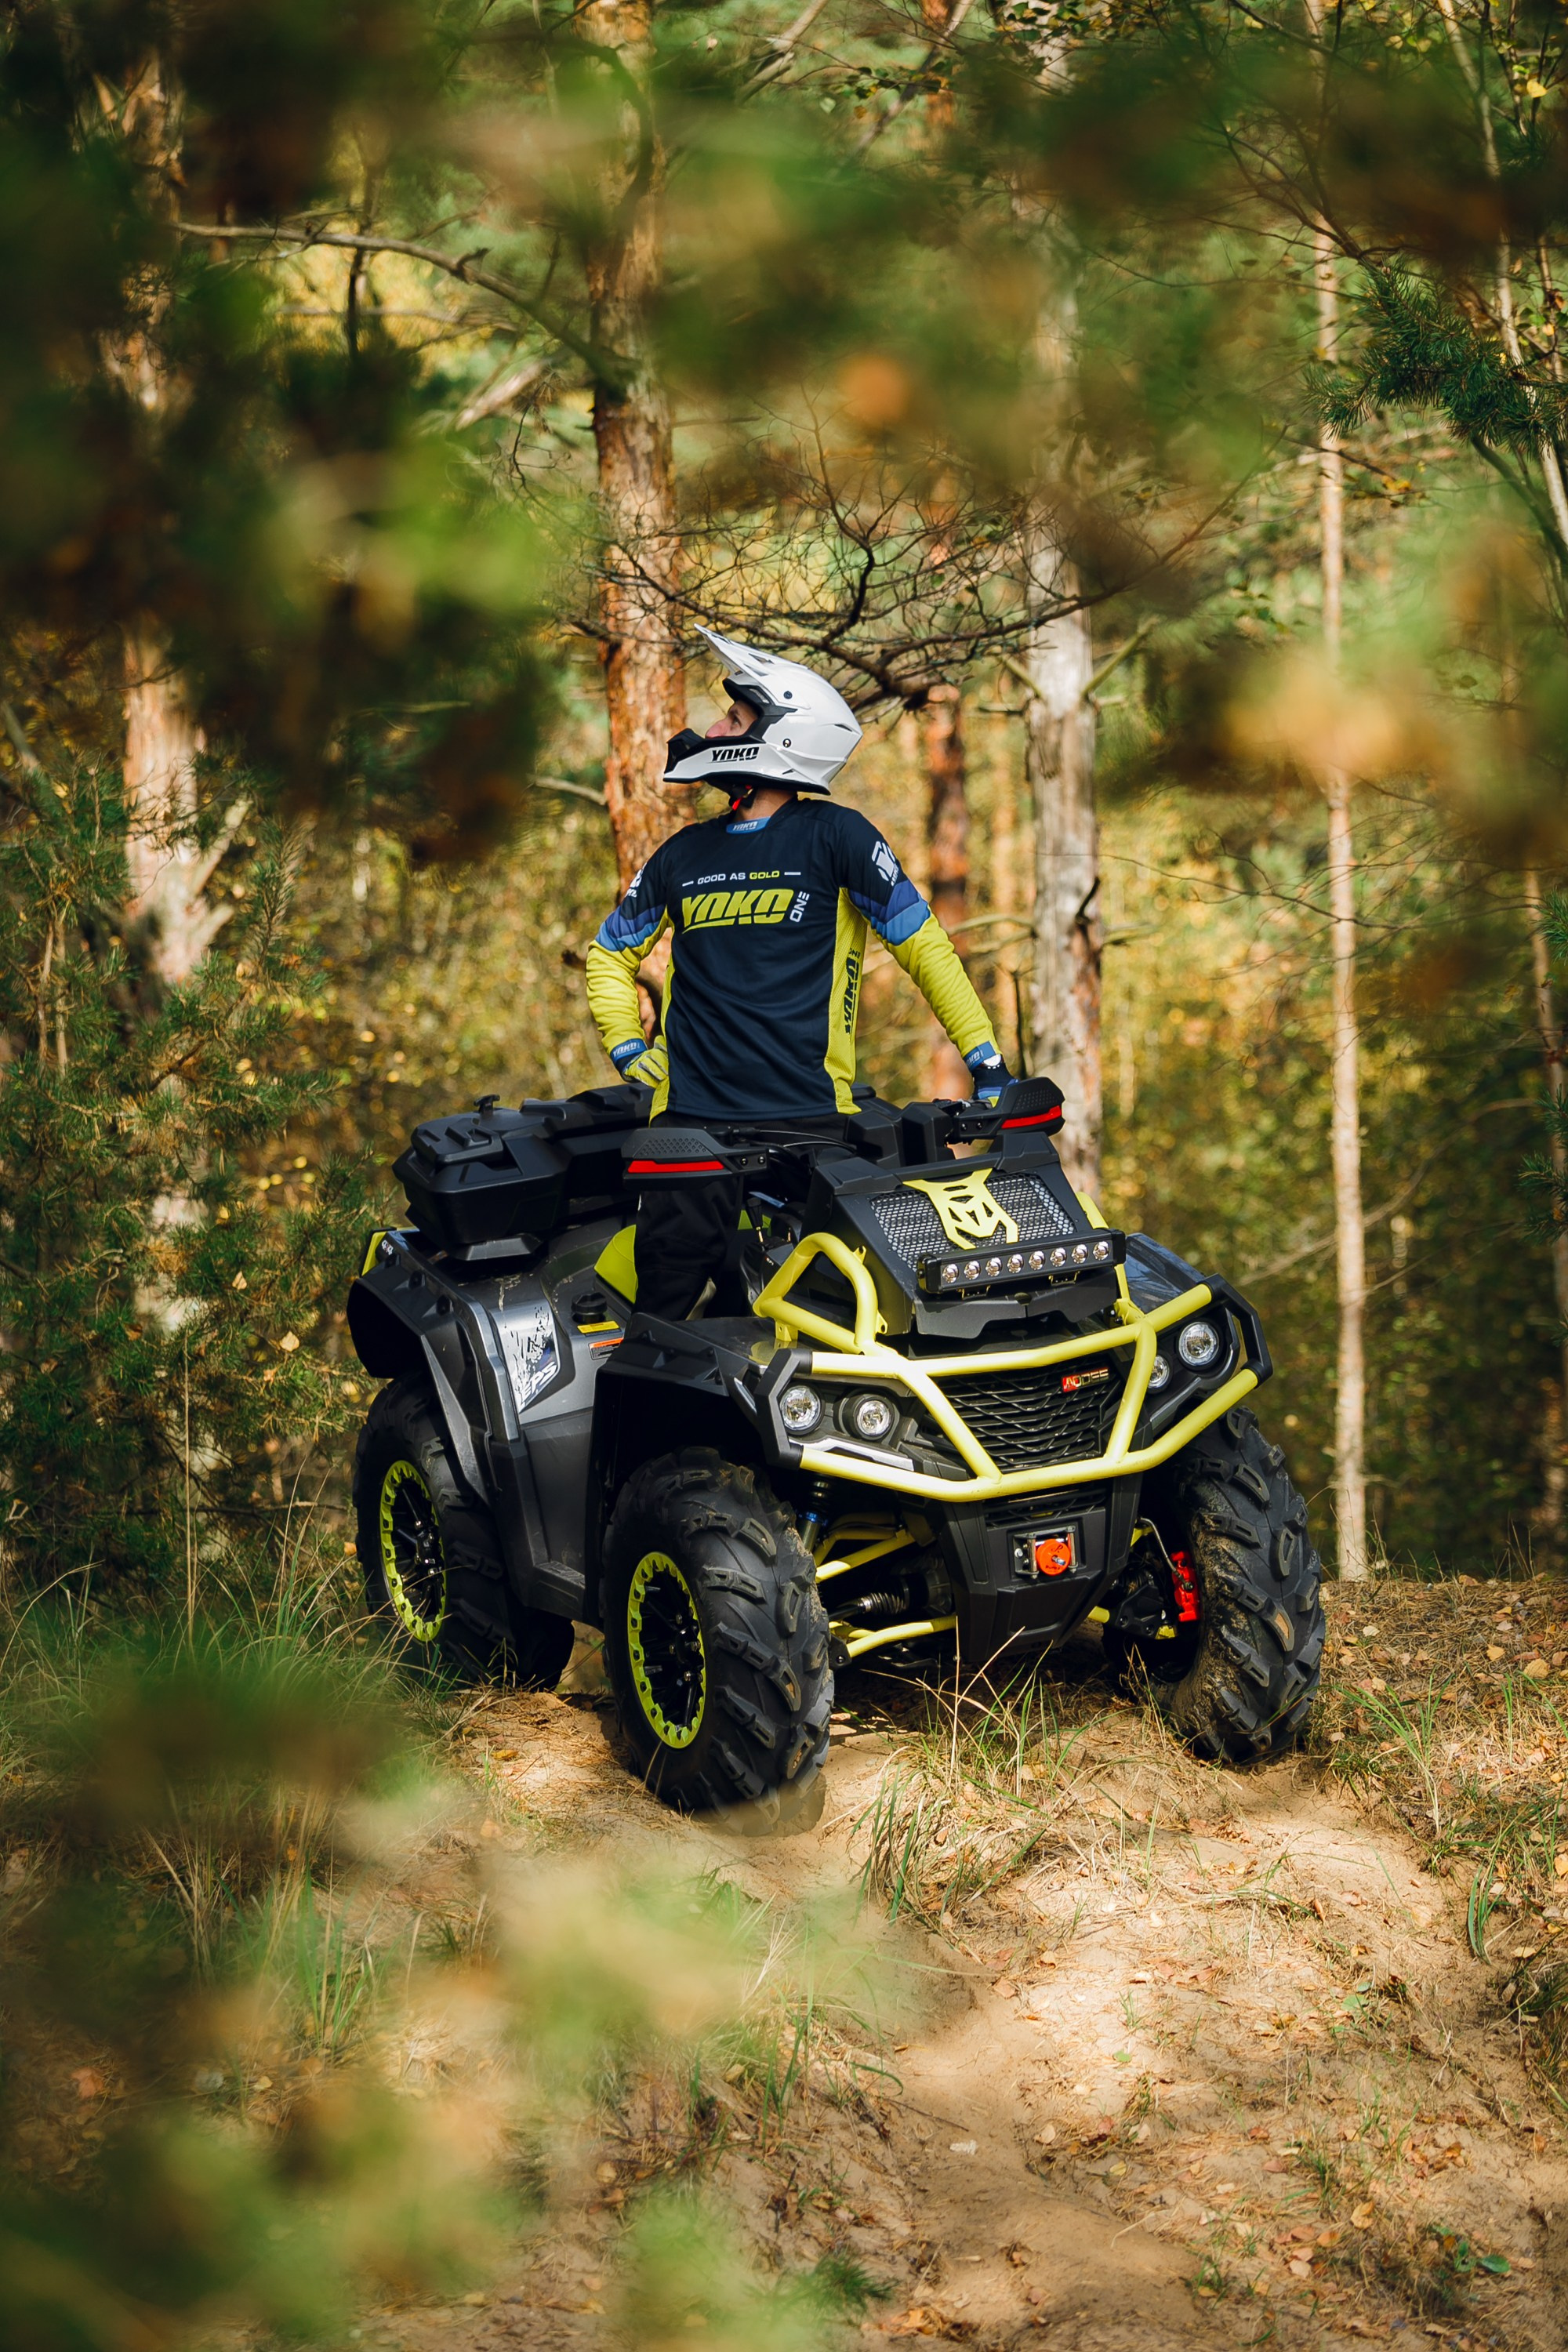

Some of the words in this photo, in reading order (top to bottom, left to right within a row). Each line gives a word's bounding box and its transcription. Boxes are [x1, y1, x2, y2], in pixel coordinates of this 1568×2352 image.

[709, 747, 759, 763] YOKO
[733, 821, 757, 830] YOKO
[697, 873, 726, 884] GOOD
[750, 870, 780, 880] GOLD
[682, 888, 794, 934] YOKO
[789, 891, 810, 923] ONE
[521, 1362, 557, 1403] EPS
